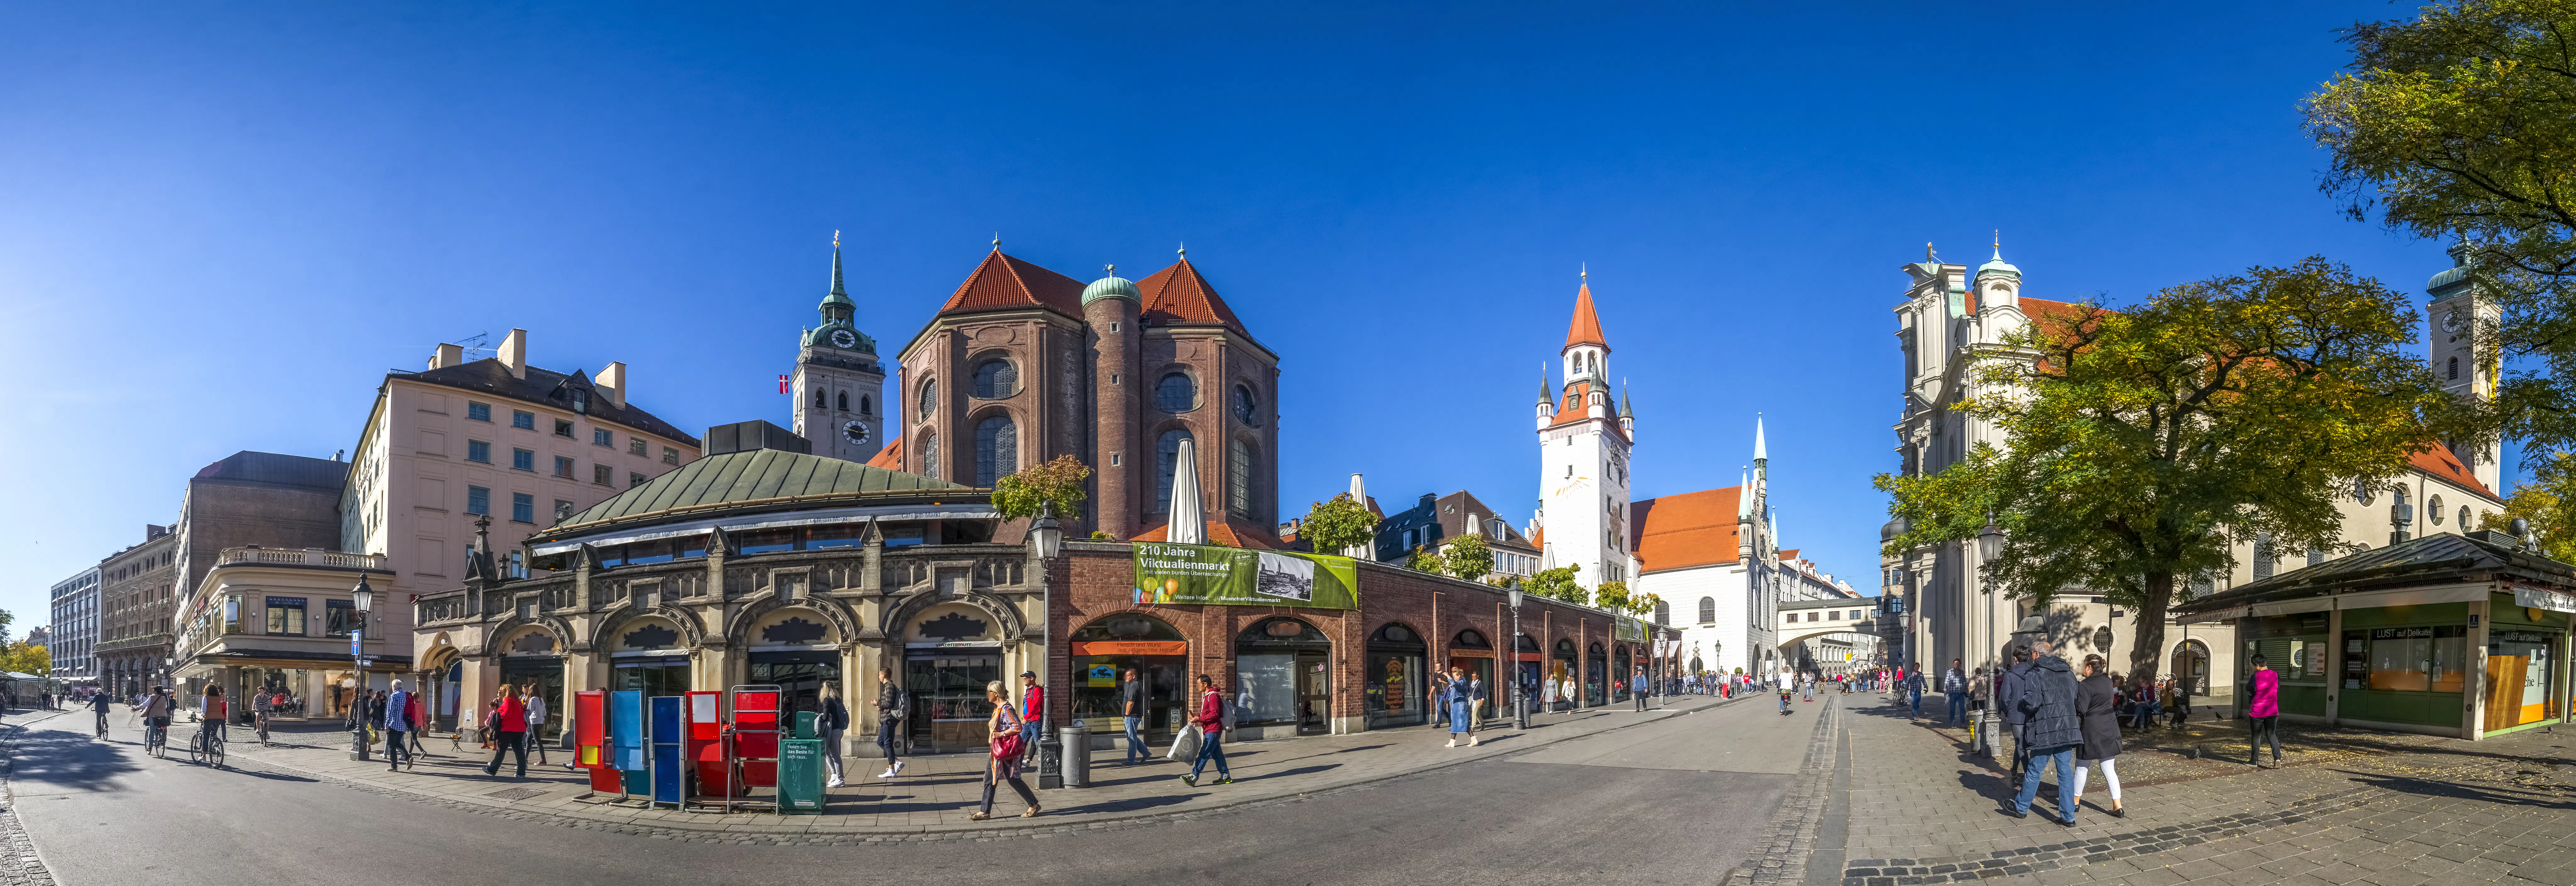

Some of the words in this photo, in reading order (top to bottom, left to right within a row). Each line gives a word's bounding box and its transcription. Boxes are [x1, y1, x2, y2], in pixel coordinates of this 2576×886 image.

[1140, 545, 1160, 555] 210
[1163, 546, 1195, 557] Jahre
[1140, 558, 1230, 571] Viktualienmarkt
[2377, 629, 2396, 638] LUST
[2505, 631, 2518, 640] LUST
